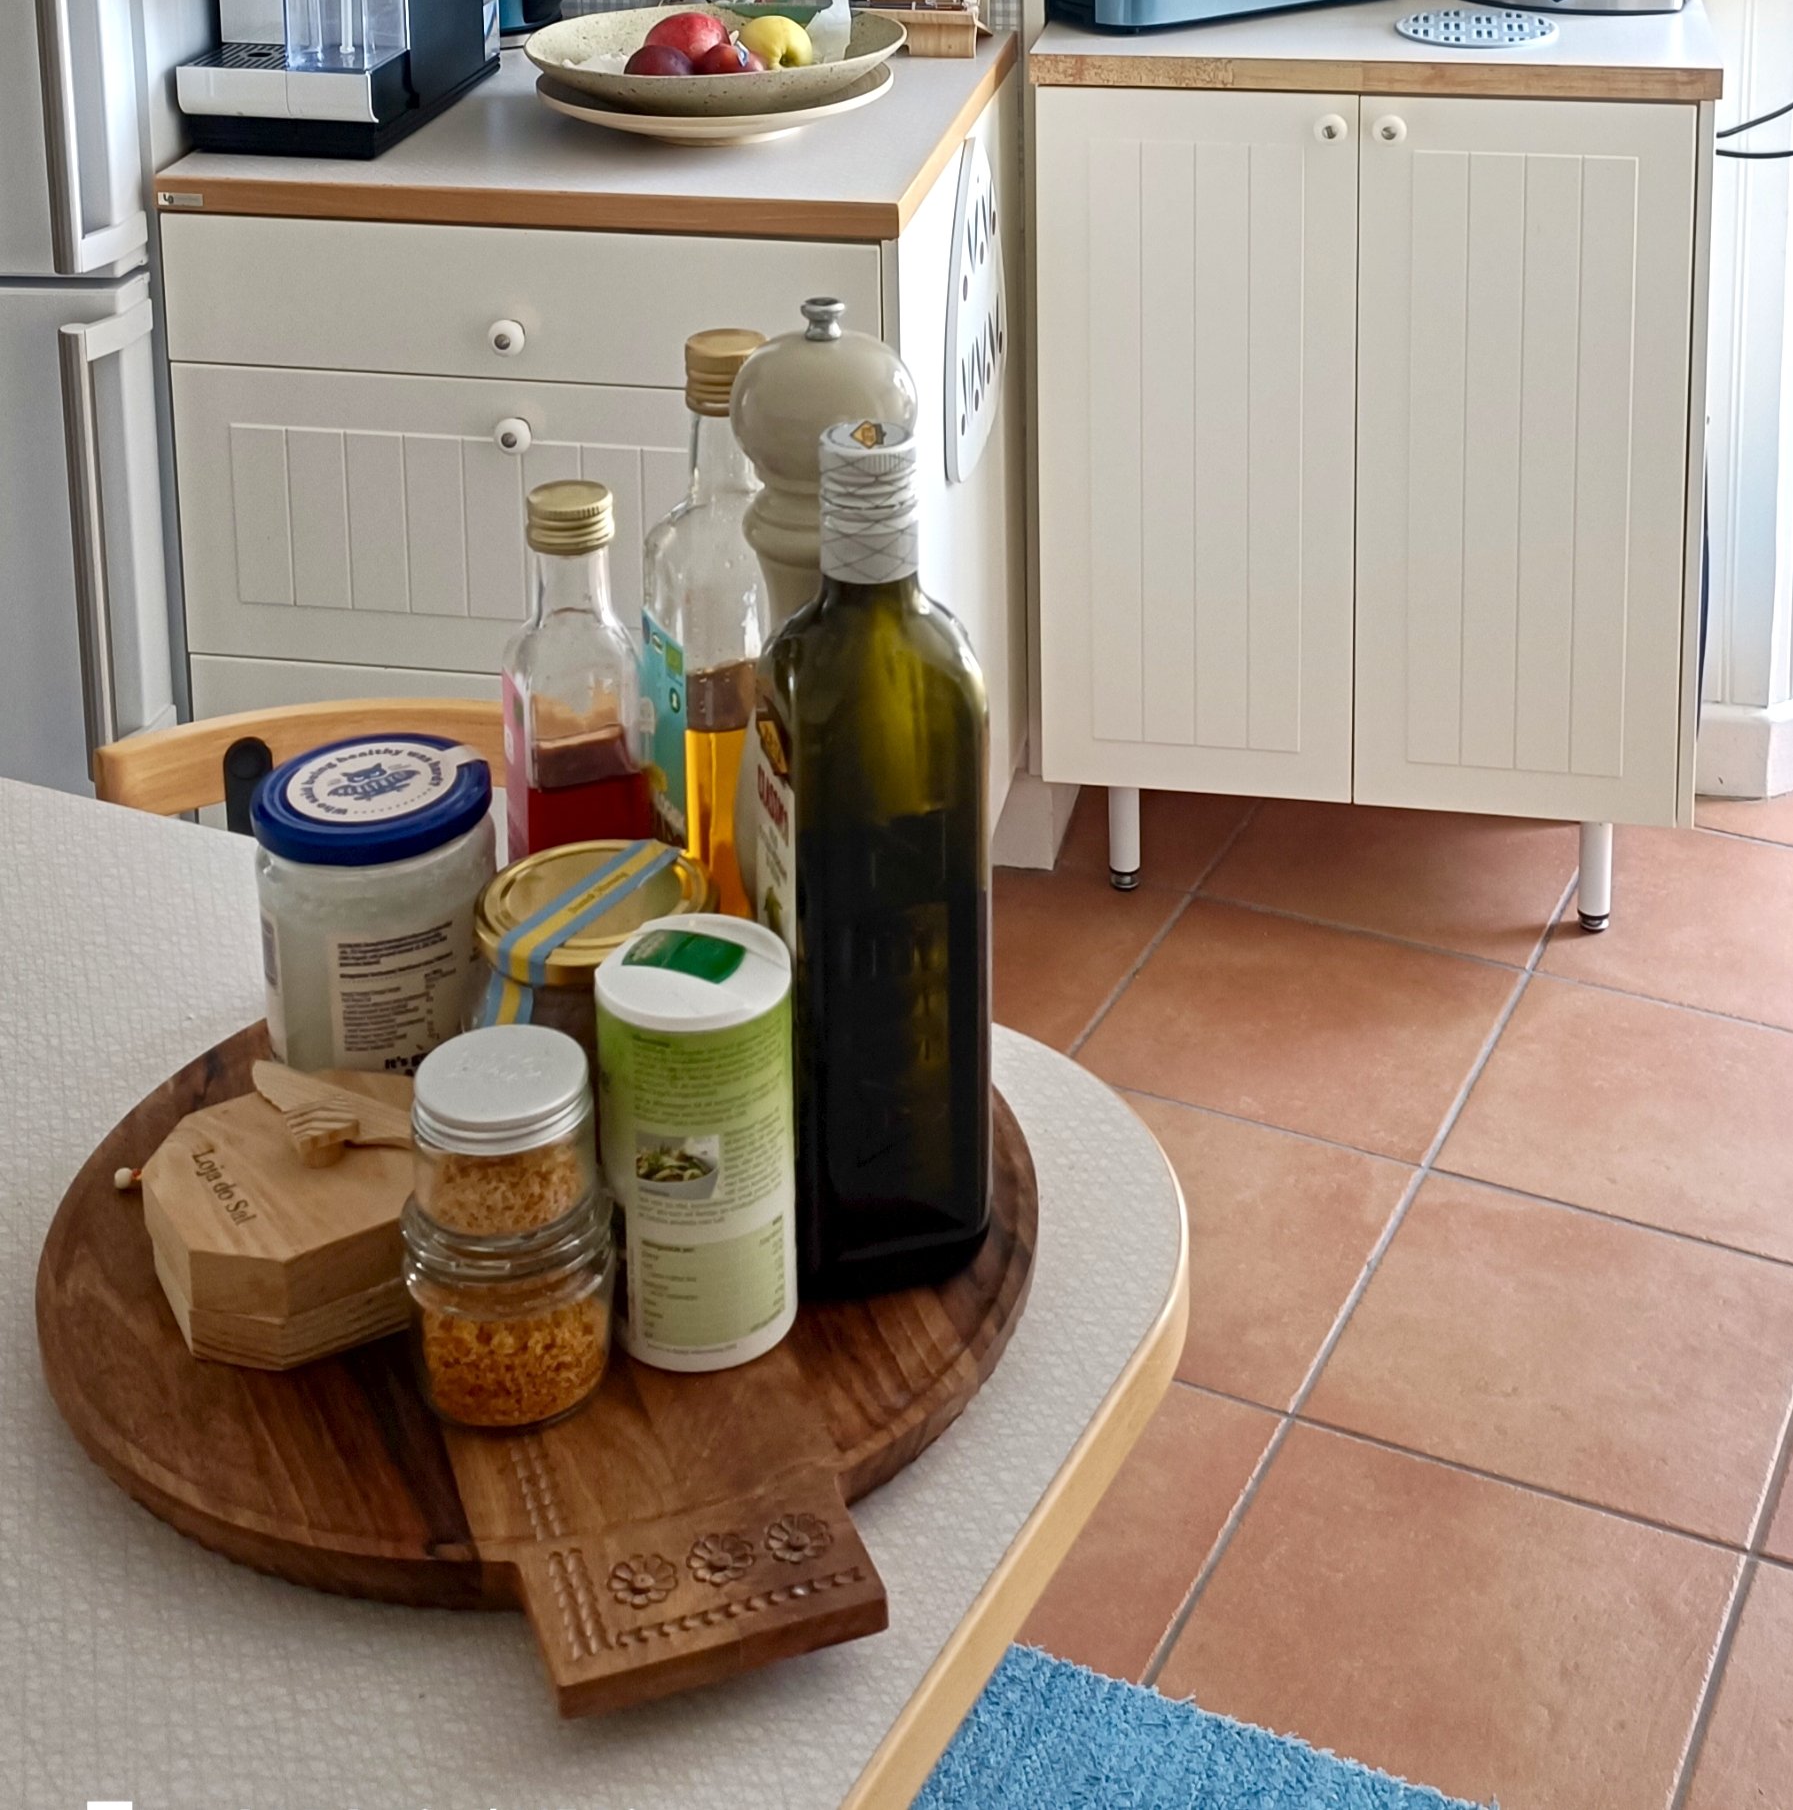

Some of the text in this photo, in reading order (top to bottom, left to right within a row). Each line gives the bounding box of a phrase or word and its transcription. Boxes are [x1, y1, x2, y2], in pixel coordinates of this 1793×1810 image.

[336, 747, 404, 764] healthy
[407, 750, 434, 763] was
[191, 1147, 257, 1226] Loja do Sal
